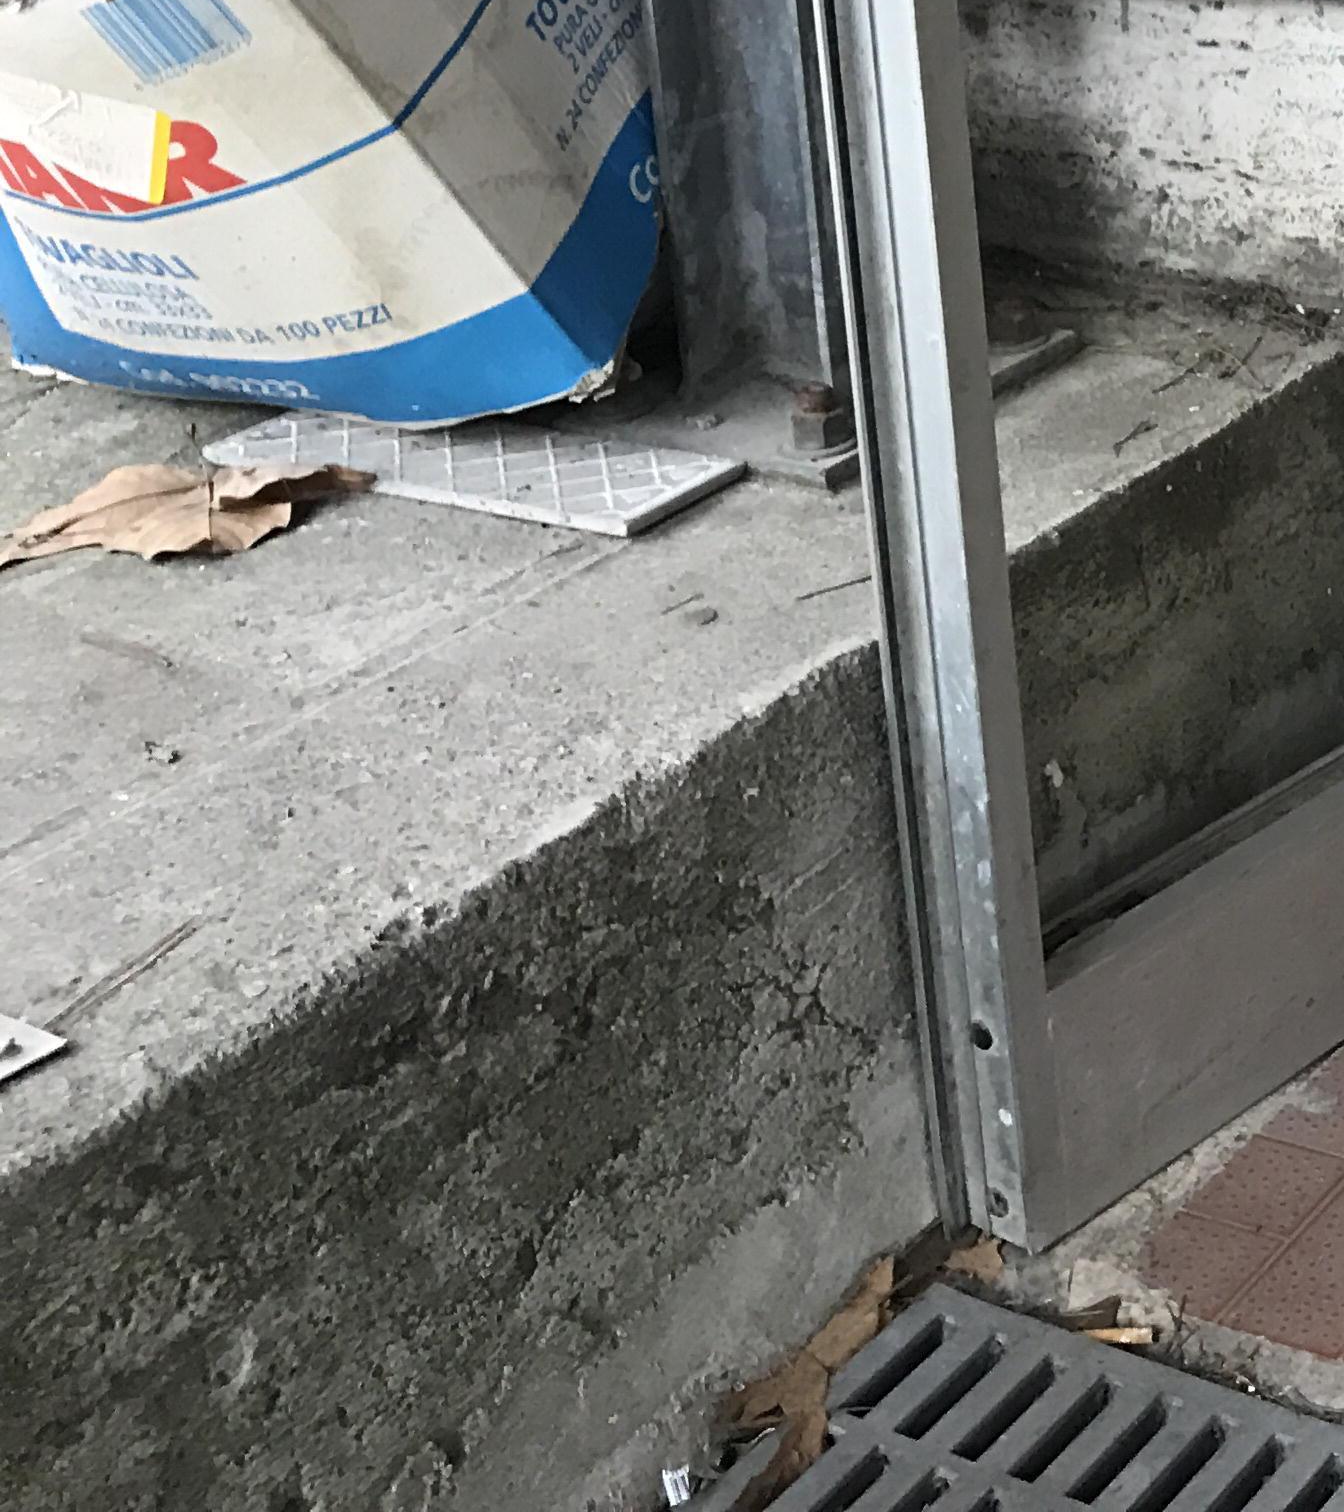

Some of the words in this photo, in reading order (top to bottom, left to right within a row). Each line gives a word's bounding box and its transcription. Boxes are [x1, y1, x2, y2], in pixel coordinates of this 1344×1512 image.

[554, 4, 588, 54] PURA
[237, 327, 274, 345] DA
[277, 320, 320, 342] 100
[322, 303, 392, 336] PEZZI
